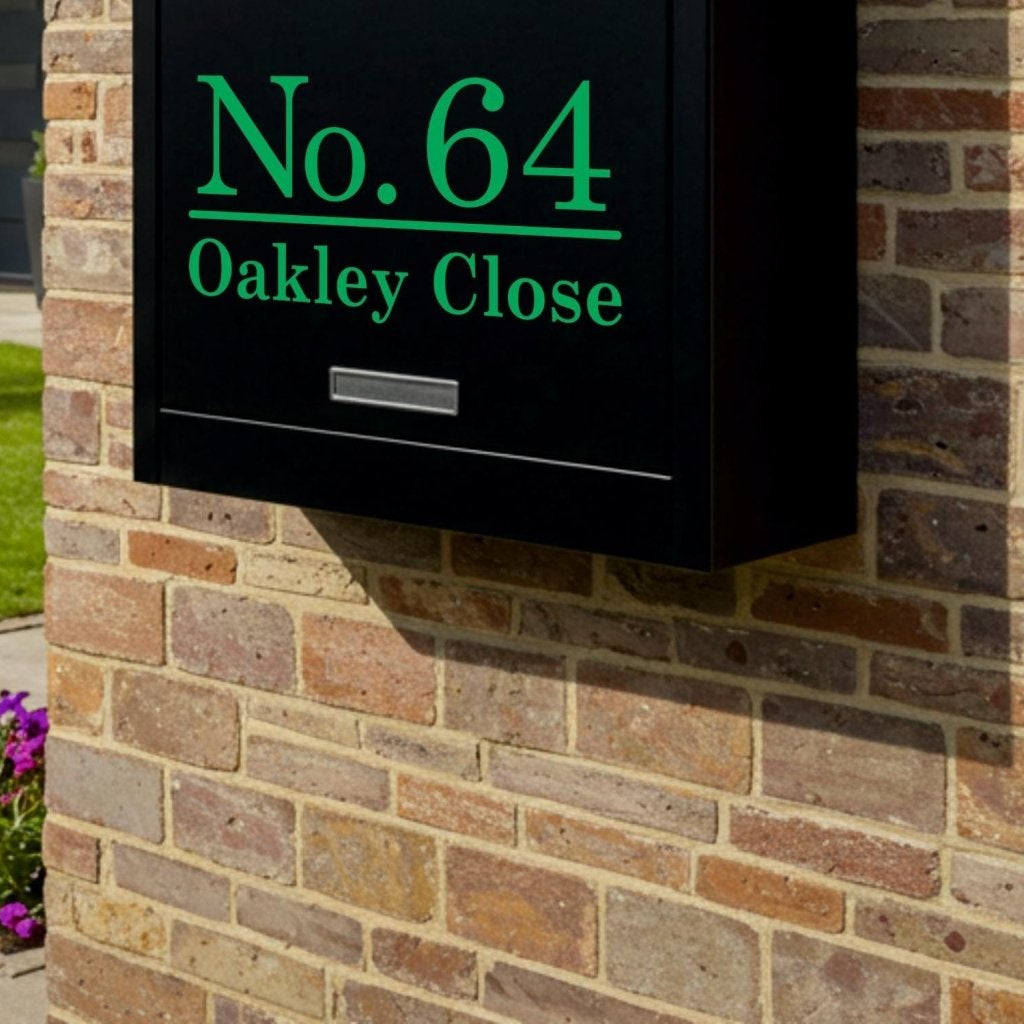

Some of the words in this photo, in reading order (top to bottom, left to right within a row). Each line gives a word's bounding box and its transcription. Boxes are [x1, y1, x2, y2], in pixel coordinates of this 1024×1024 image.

[195, 73, 399, 207] No.
[424, 75, 613, 213] 64
[187, 236, 409, 326] Oakley
[431, 250, 624, 328] Close
